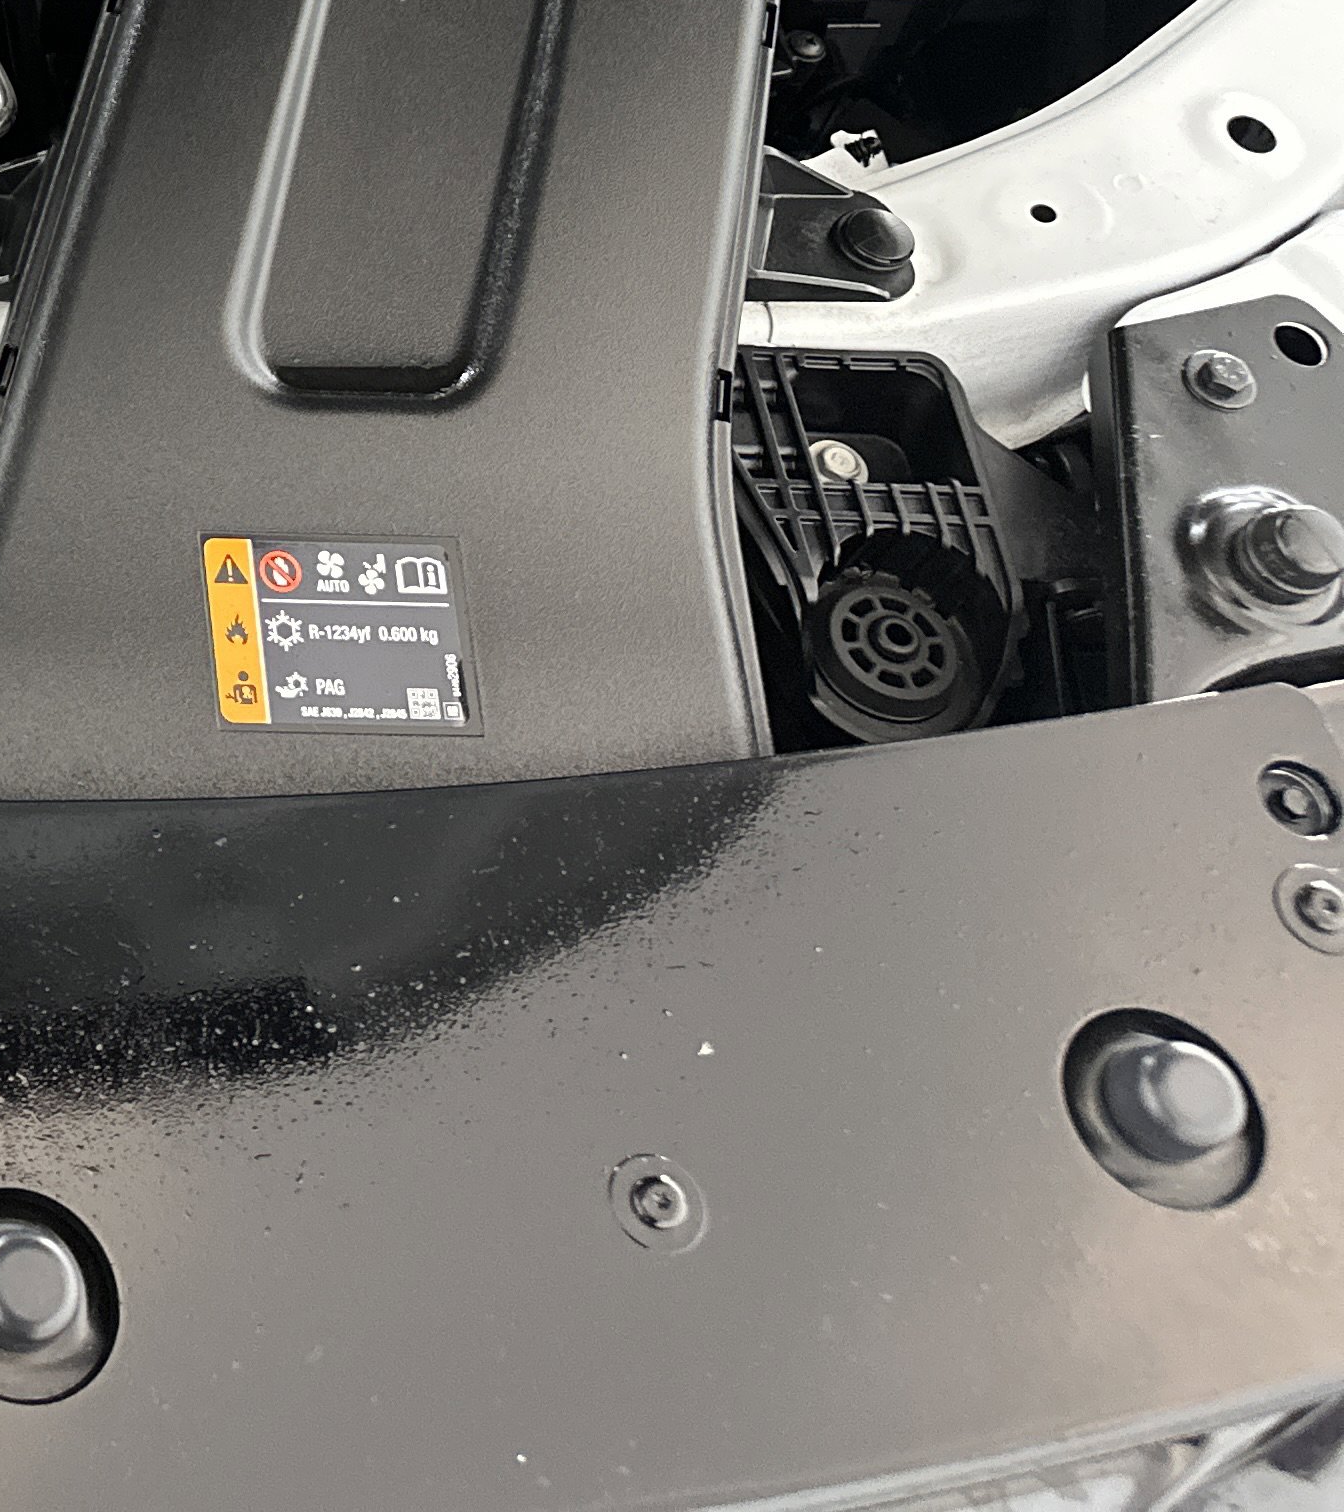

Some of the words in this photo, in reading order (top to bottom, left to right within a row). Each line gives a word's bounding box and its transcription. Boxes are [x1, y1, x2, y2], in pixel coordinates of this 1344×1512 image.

[316, 579, 350, 593] AUTO
[308, 624, 372, 644] R-1234yf
[378, 626, 418, 642] 0.600
[420, 626, 439, 645] kg
[315, 678, 346, 696] PAG
